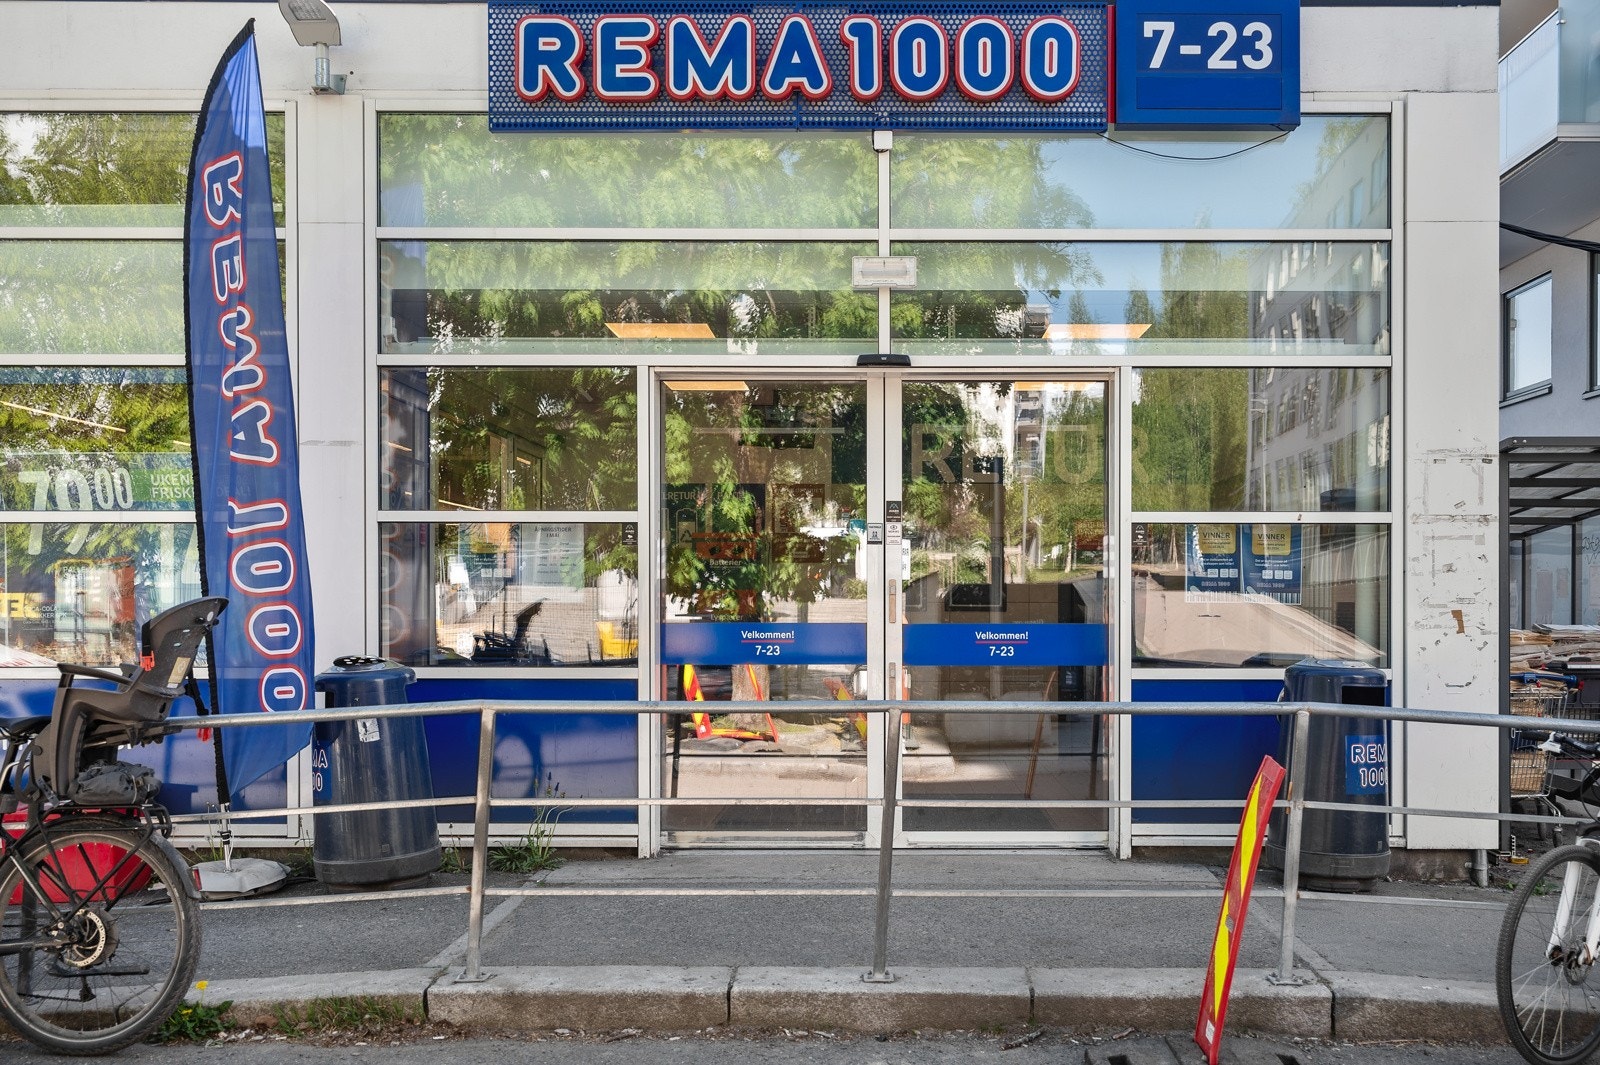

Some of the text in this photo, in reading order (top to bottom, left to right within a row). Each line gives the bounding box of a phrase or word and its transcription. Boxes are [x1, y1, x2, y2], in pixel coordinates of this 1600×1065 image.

[1142, 20, 1274, 72] 7-23
[515, 14, 1081, 103] REMA 1000
[150, 473, 193, 485] UKEN
[151, 487, 194, 499] FRISK
[741, 630, 795, 639] Velkommen!
[975, 631, 1029, 640] Velkommen!
[755, 645, 781, 656] 7-23
[989, 646, 1014, 657] 7-23
